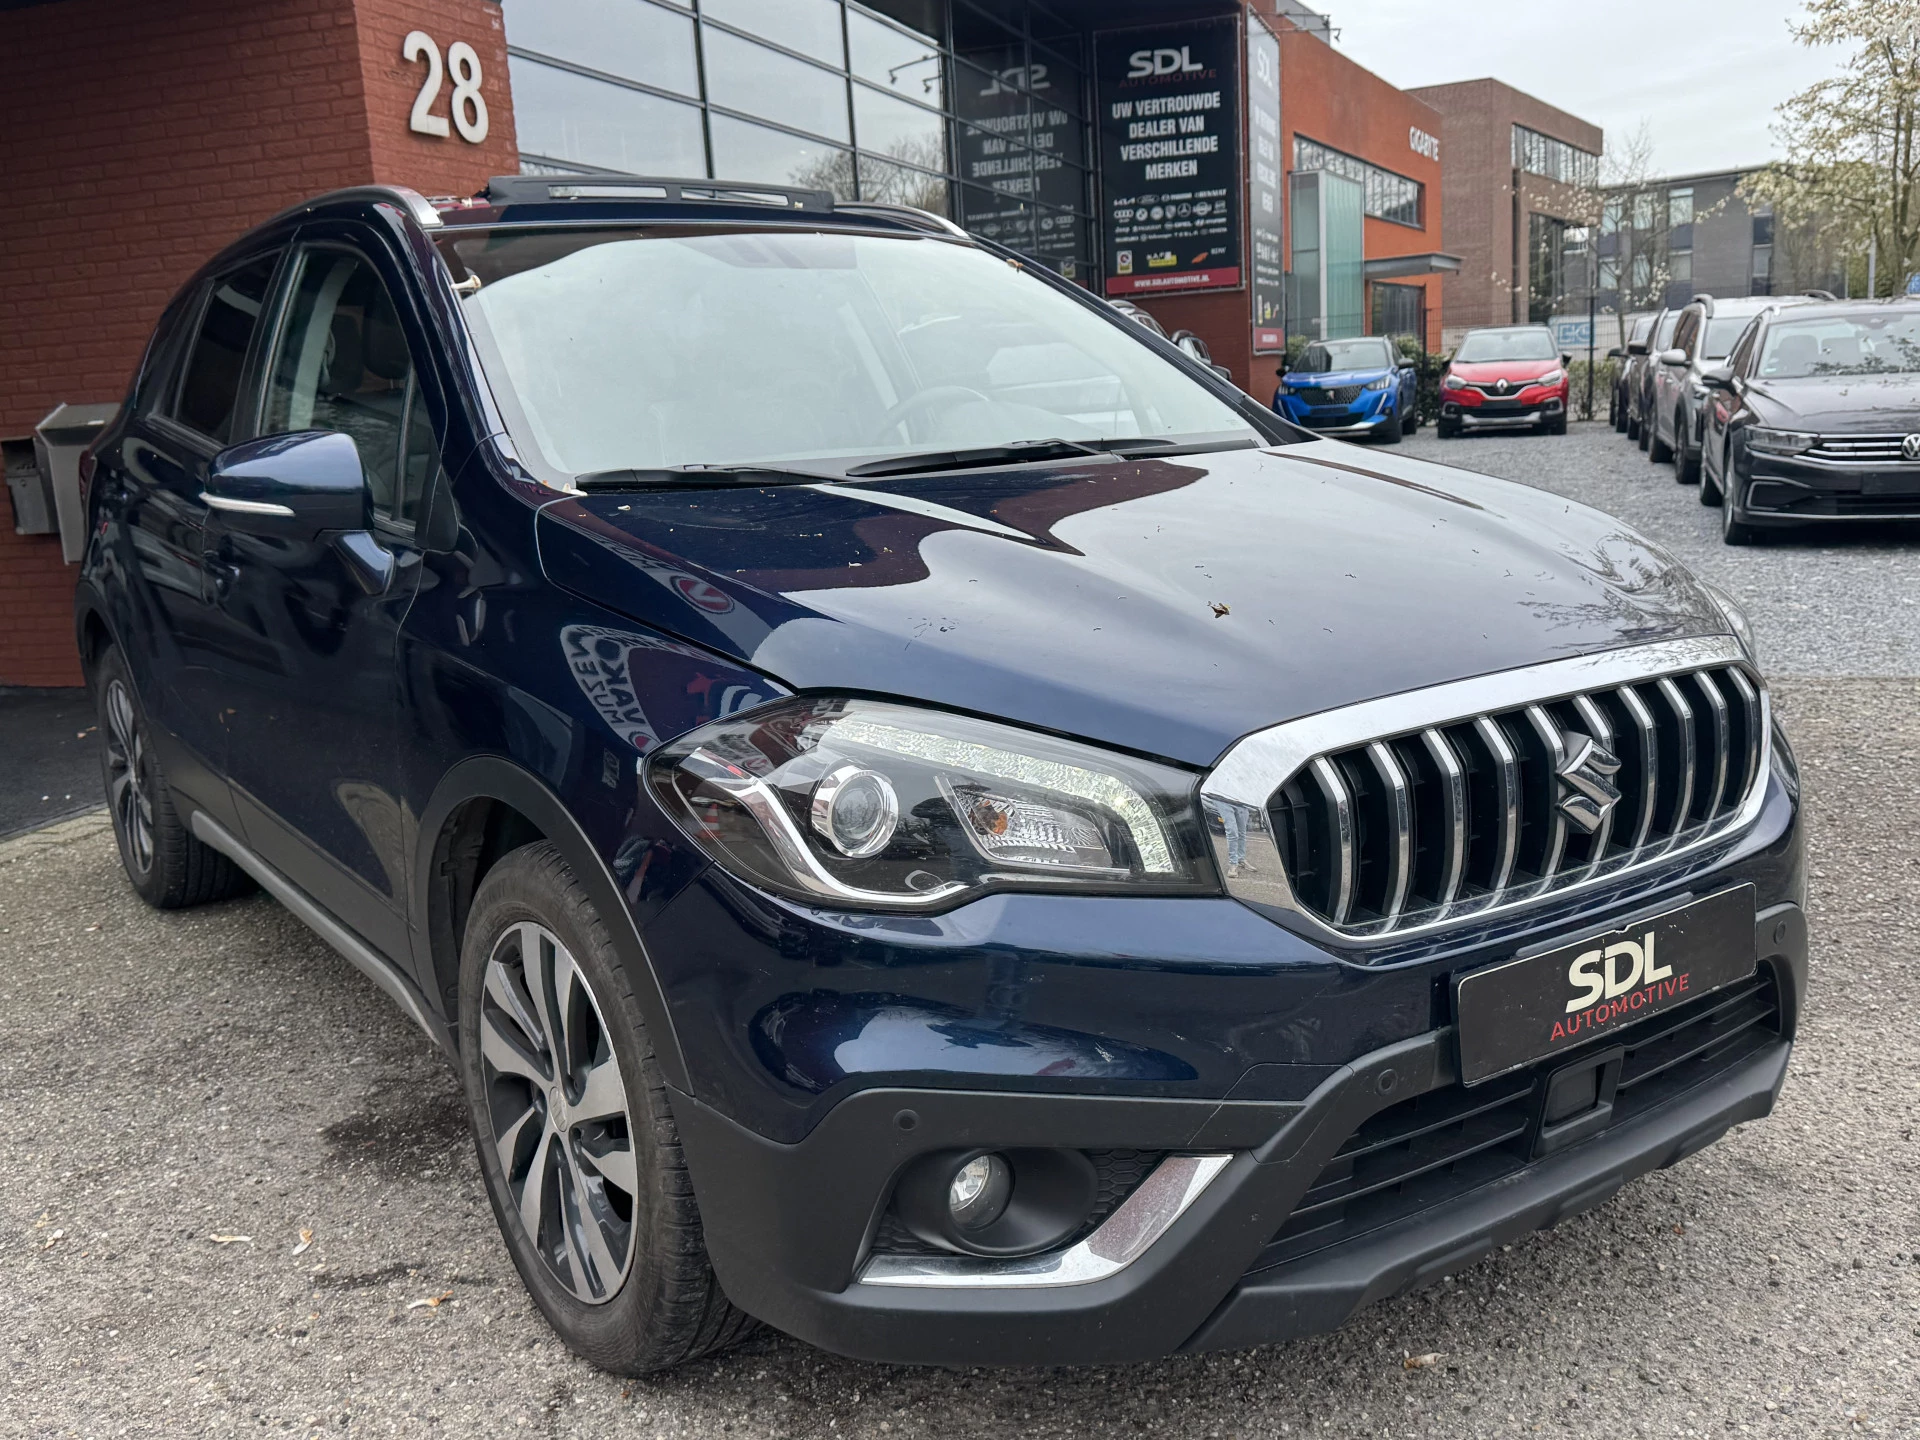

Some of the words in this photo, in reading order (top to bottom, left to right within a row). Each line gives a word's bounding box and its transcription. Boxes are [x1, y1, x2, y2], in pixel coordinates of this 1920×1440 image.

[1127, 45, 1203, 78] SDL
[403, 30, 489, 144] 28
[1119, 69, 1217, 88] AUTOMOTIVE
[1112, 101, 1132, 119] UW
[1135, 91, 1221, 117] VERTROUWDE
[1129, 118, 1176, 139] DEALER
[1179, 115, 1204, 133] VAN
[1120, 135, 1219, 161] VERSCHILLENDE
[1145, 159, 1198, 180] MERKEN
[1565, 931, 1673, 1014] SDL
[1550, 973, 1690, 1042] AUTOMOTIVE
